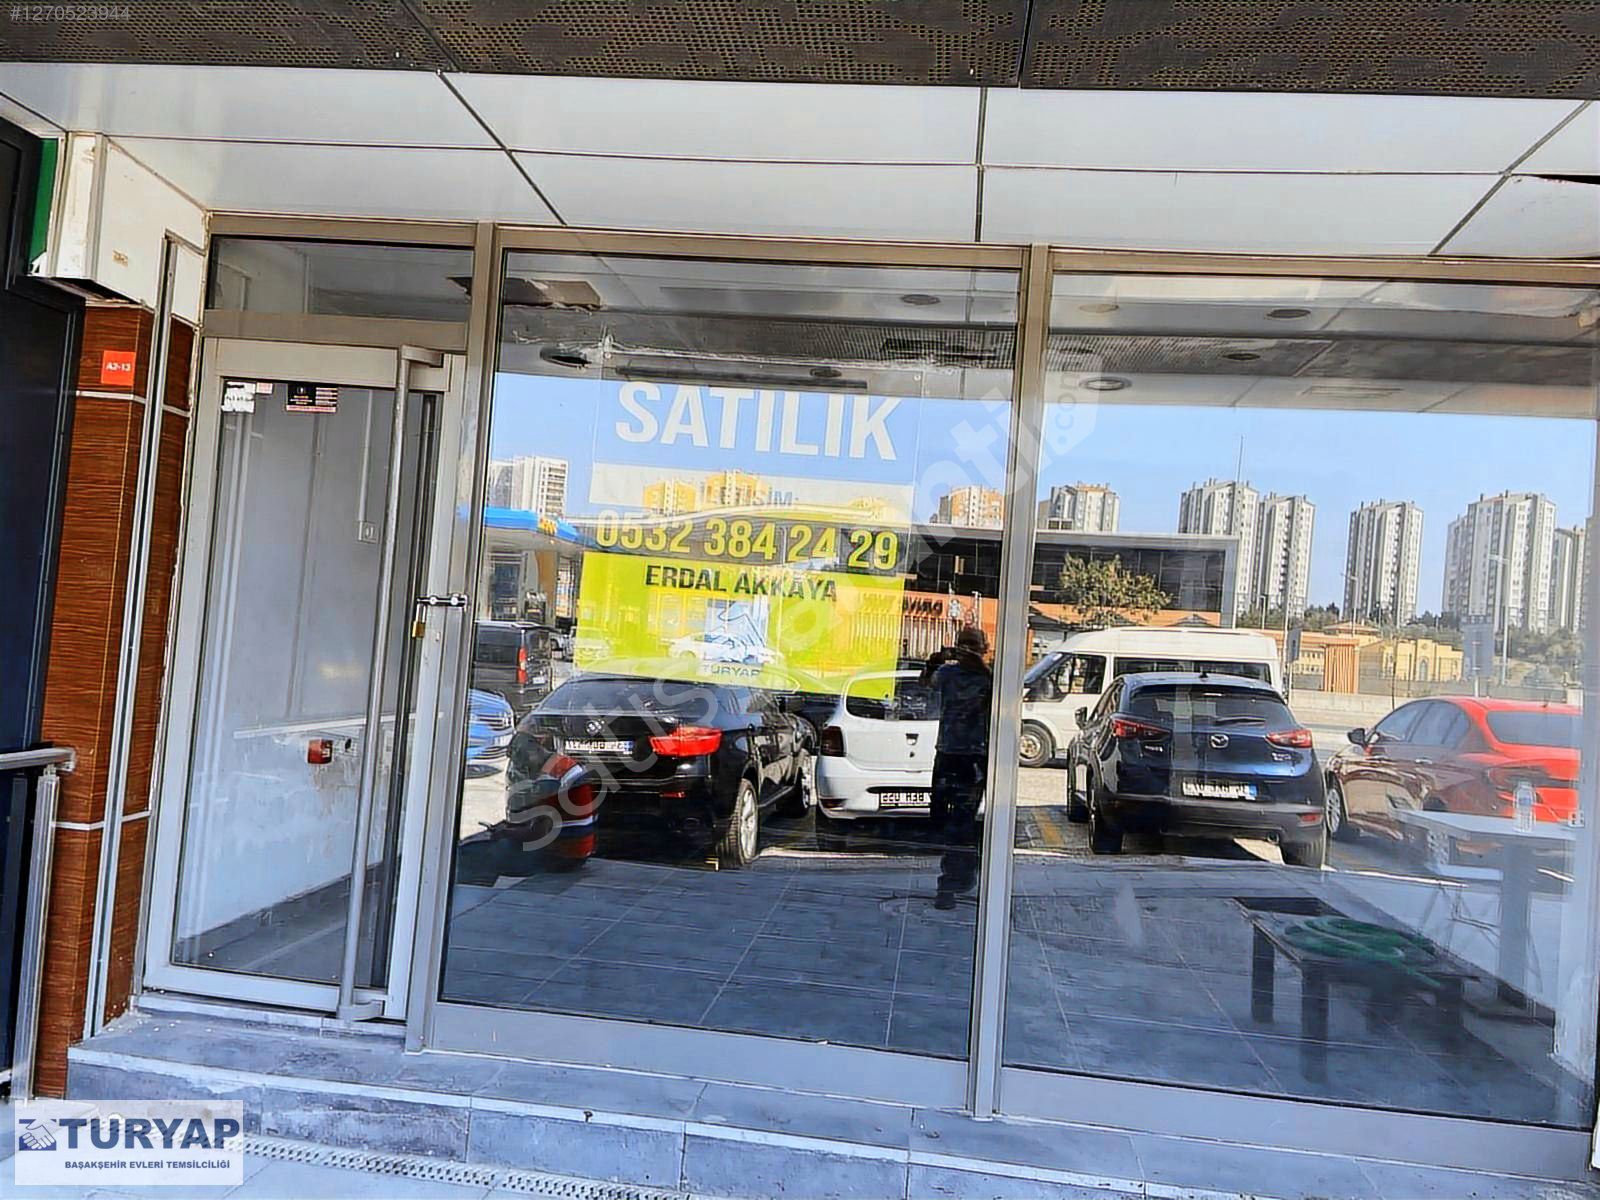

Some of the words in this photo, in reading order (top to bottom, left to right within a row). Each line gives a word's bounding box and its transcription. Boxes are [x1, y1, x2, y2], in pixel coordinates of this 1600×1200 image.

[615, 381, 903, 461] SATILIK
[596, 509, 693, 553] 0532
[703, 518, 778, 560] 384
[786, 523, 838, 563] 24
[847, 529, 899, 571] 29
[645, 565, 727, 592] ERDAL
[733, 570, 837, 602] AKKAYA
